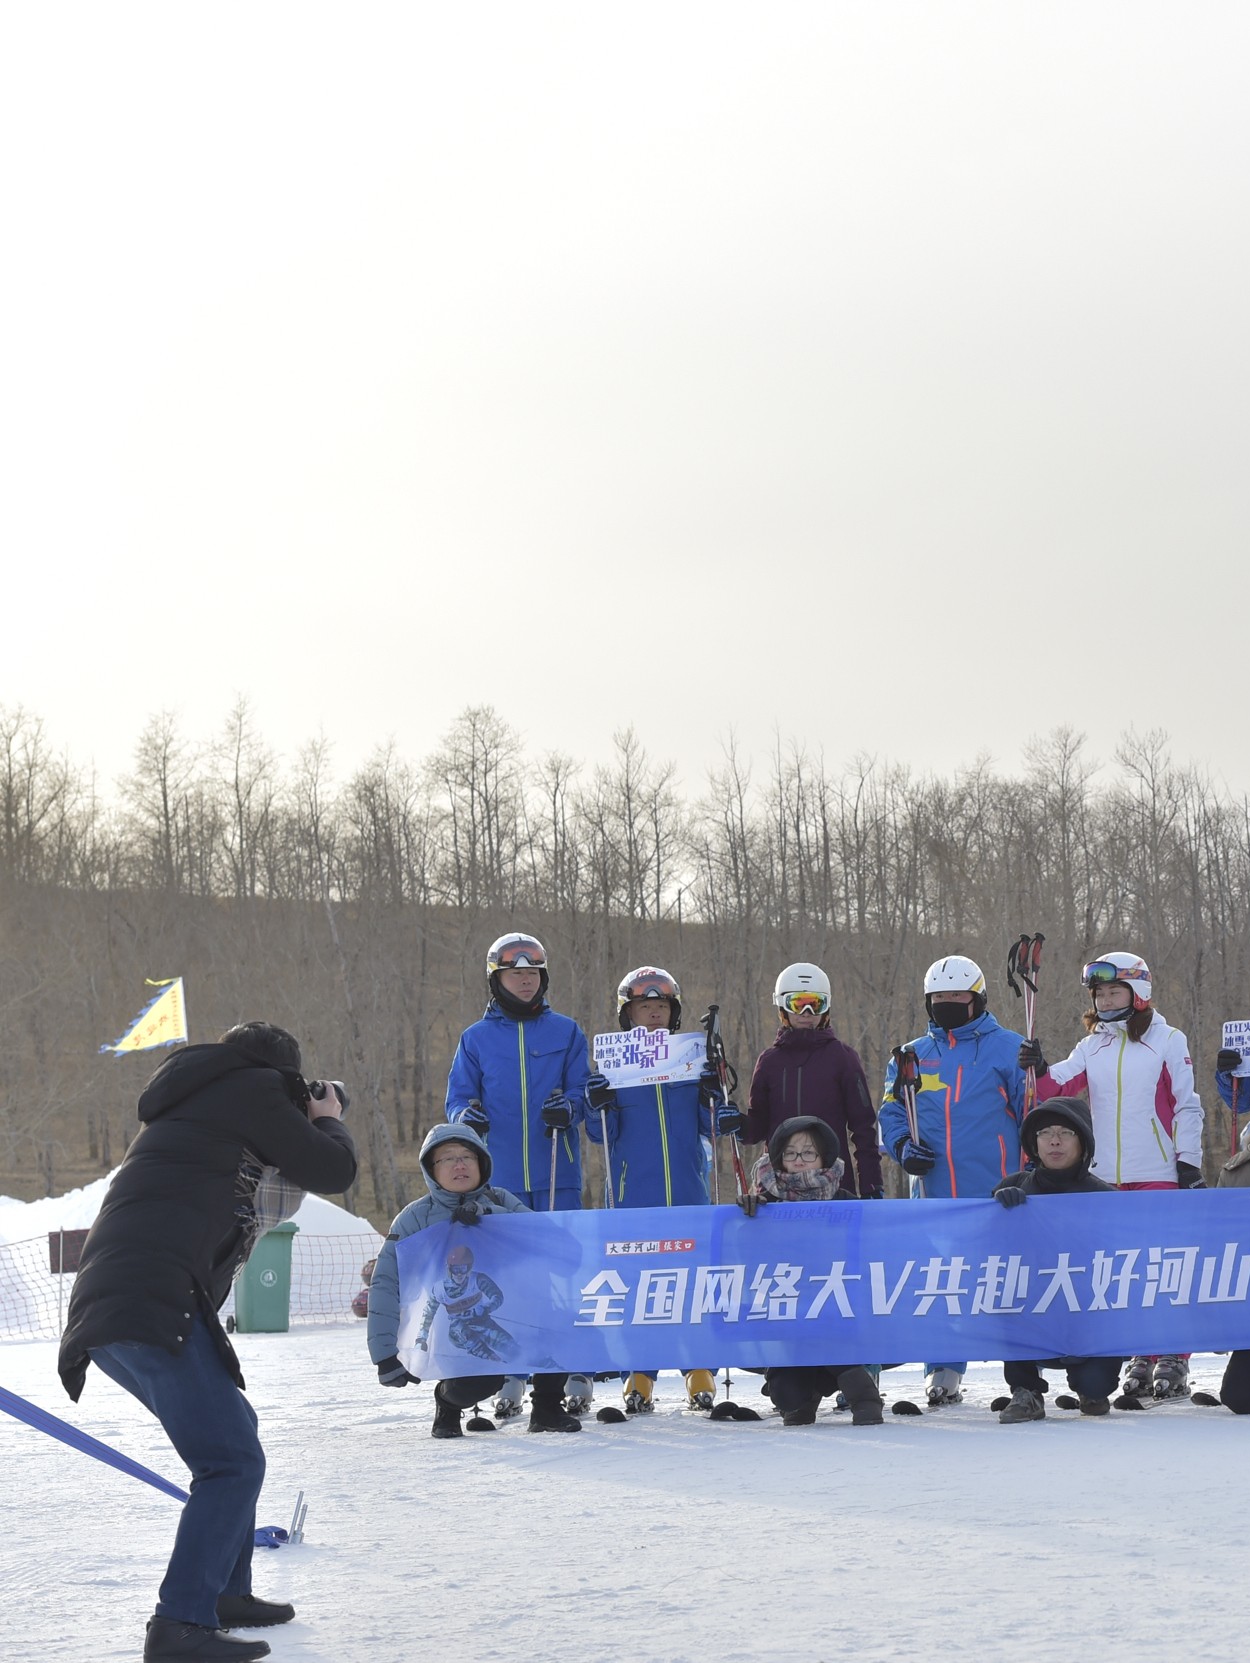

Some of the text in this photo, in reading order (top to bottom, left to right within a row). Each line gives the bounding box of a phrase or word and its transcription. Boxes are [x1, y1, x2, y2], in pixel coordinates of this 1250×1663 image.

[595, 1027, 669, 1047] 红红火火中国年
[622, 1043, 669, 1069] 张家口
[609, 1242, 656, 1254] 大好河山
